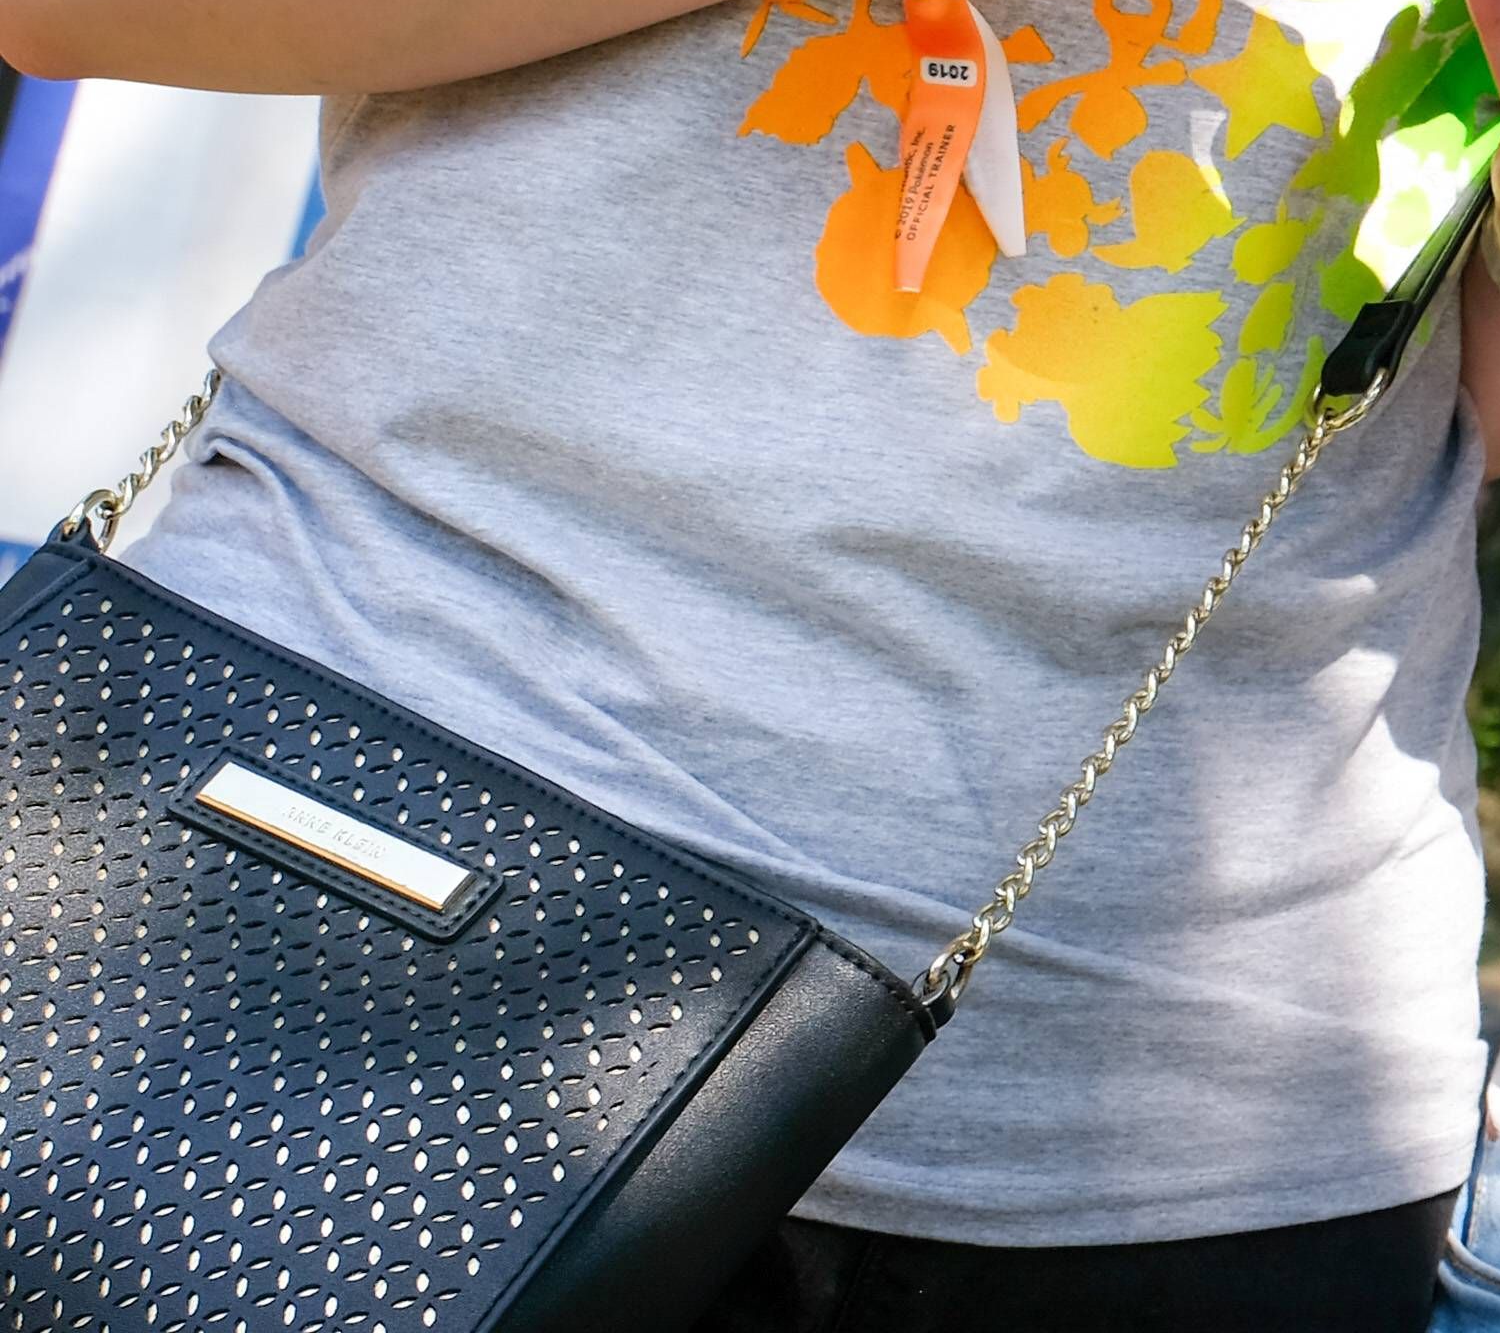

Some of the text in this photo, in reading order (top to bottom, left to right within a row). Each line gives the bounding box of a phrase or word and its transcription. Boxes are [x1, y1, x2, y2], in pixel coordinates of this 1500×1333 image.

[927, 62, 970, 81] 2019
[906, 124, 956, 242] OFFICIAL TRAINER
[332, 829, 387, 860] KLEIN
